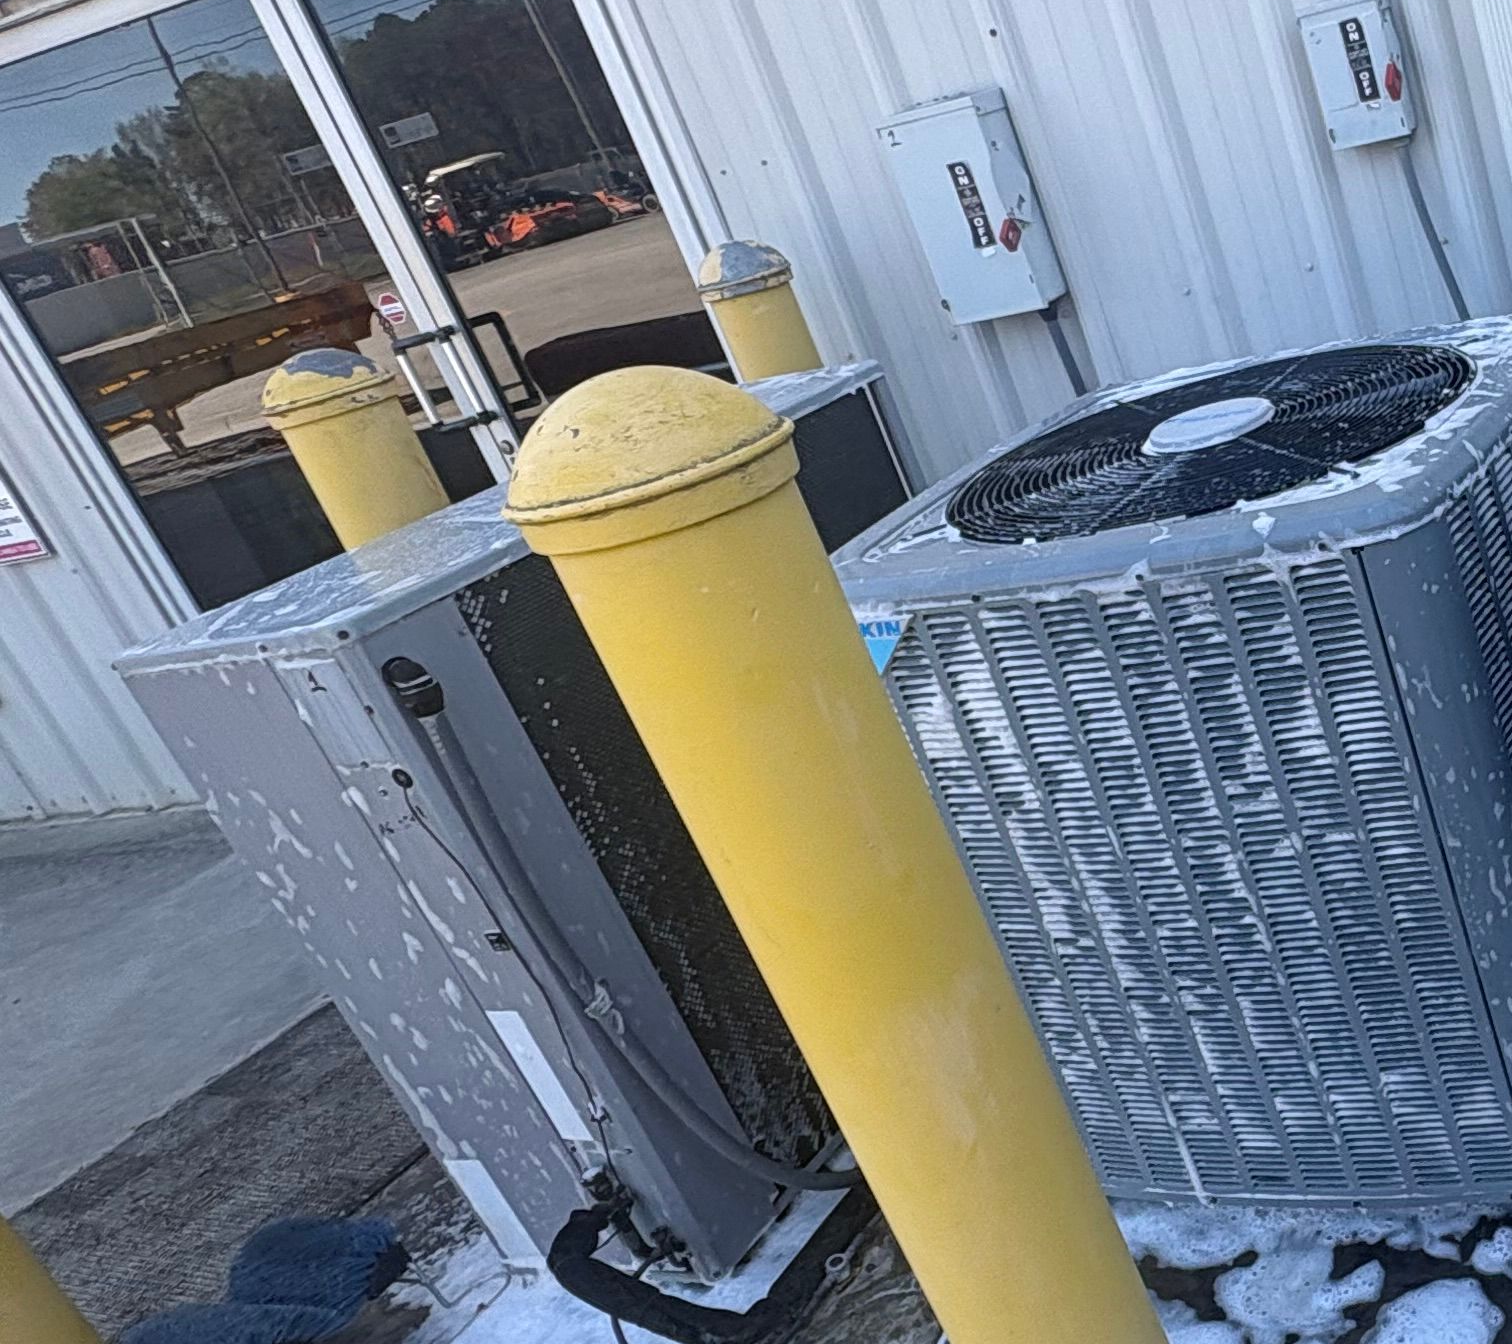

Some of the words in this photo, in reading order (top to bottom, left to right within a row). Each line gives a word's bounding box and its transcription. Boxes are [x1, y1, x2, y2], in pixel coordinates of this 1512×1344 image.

[1345, 21, 1360, 43] ON
[1358, 71, 1373, 97] OFF
[954, 165, 970, 186] ON
[972, 217, 989, 246] OFF
